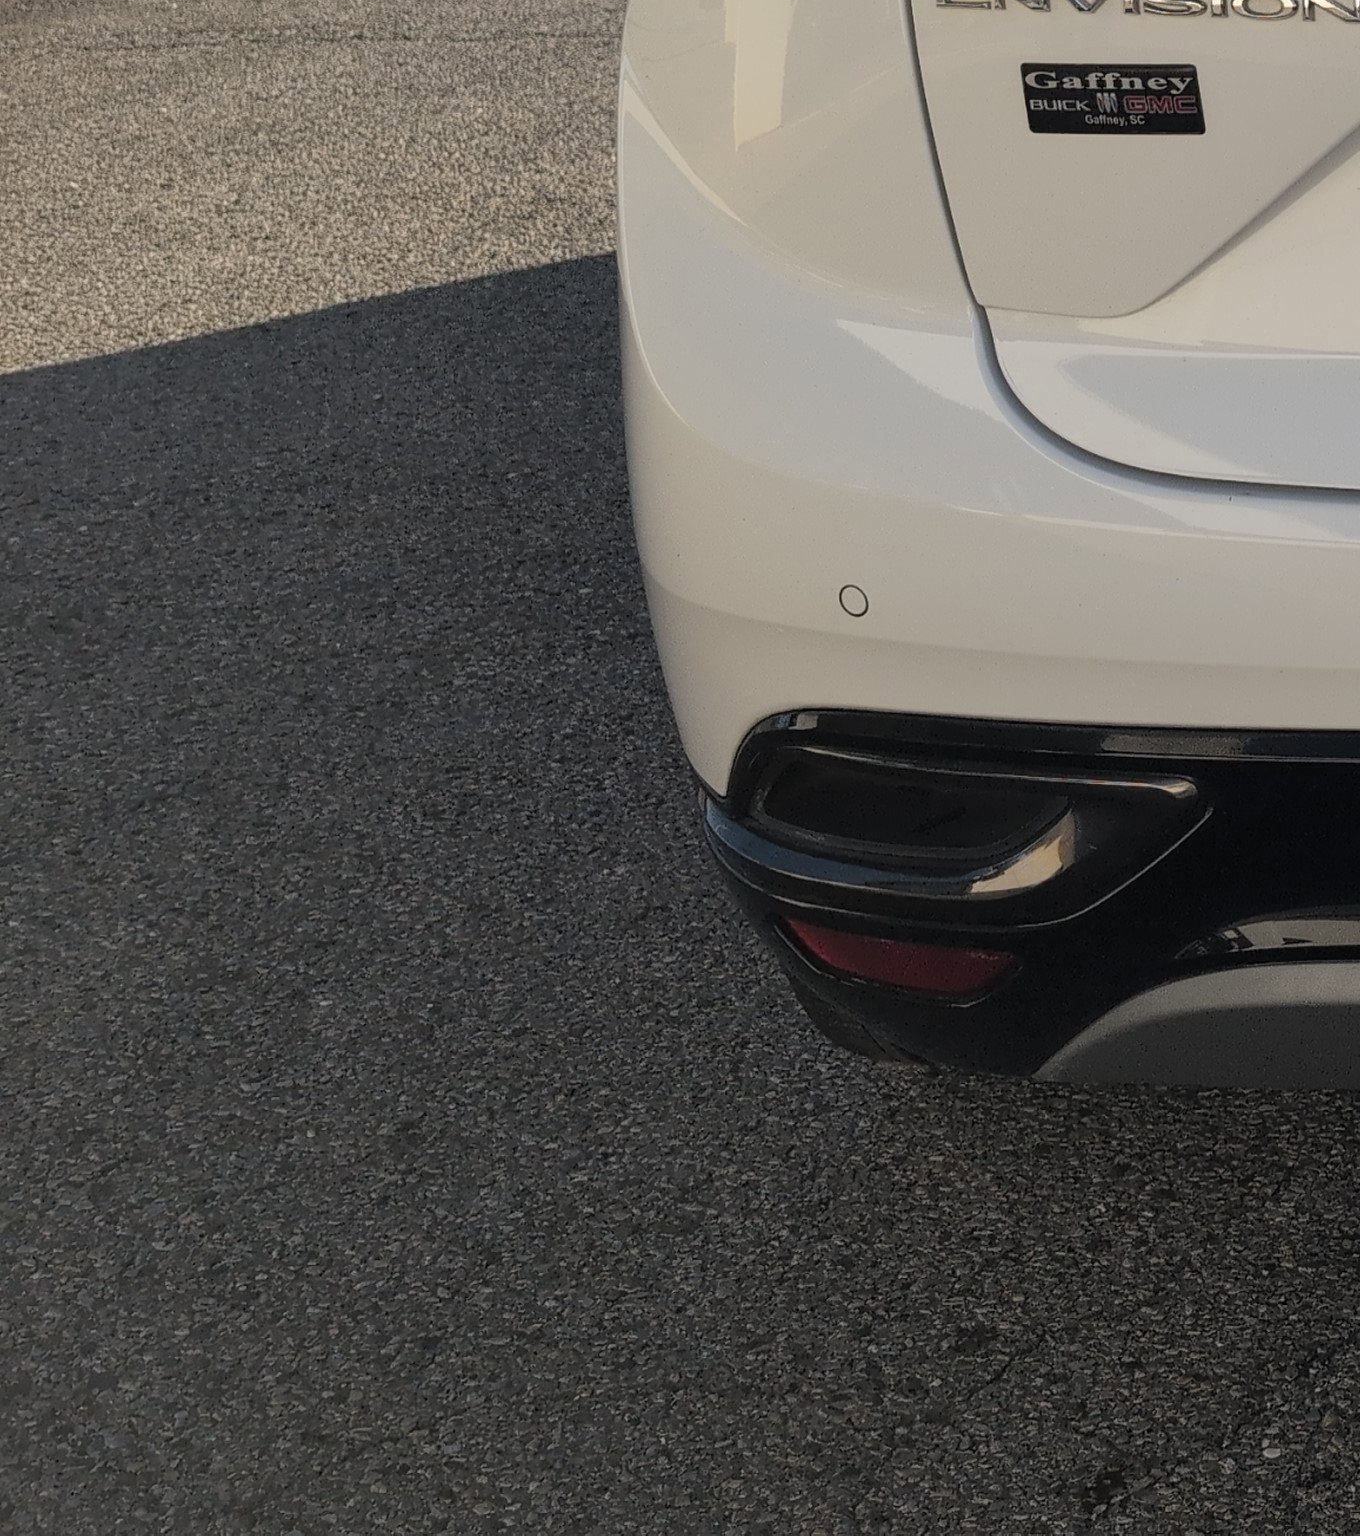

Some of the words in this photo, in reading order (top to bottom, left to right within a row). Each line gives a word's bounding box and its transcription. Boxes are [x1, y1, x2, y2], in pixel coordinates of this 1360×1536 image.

[1024, 70, 1194, 95] Gaffney
[1029, 99, 1091, 112] BUICK
[1123, 95, 1198, 114] GMC
[1084, 114, 1128, 127] Gaffney,
[1130, 115, 1146, 125] SC
